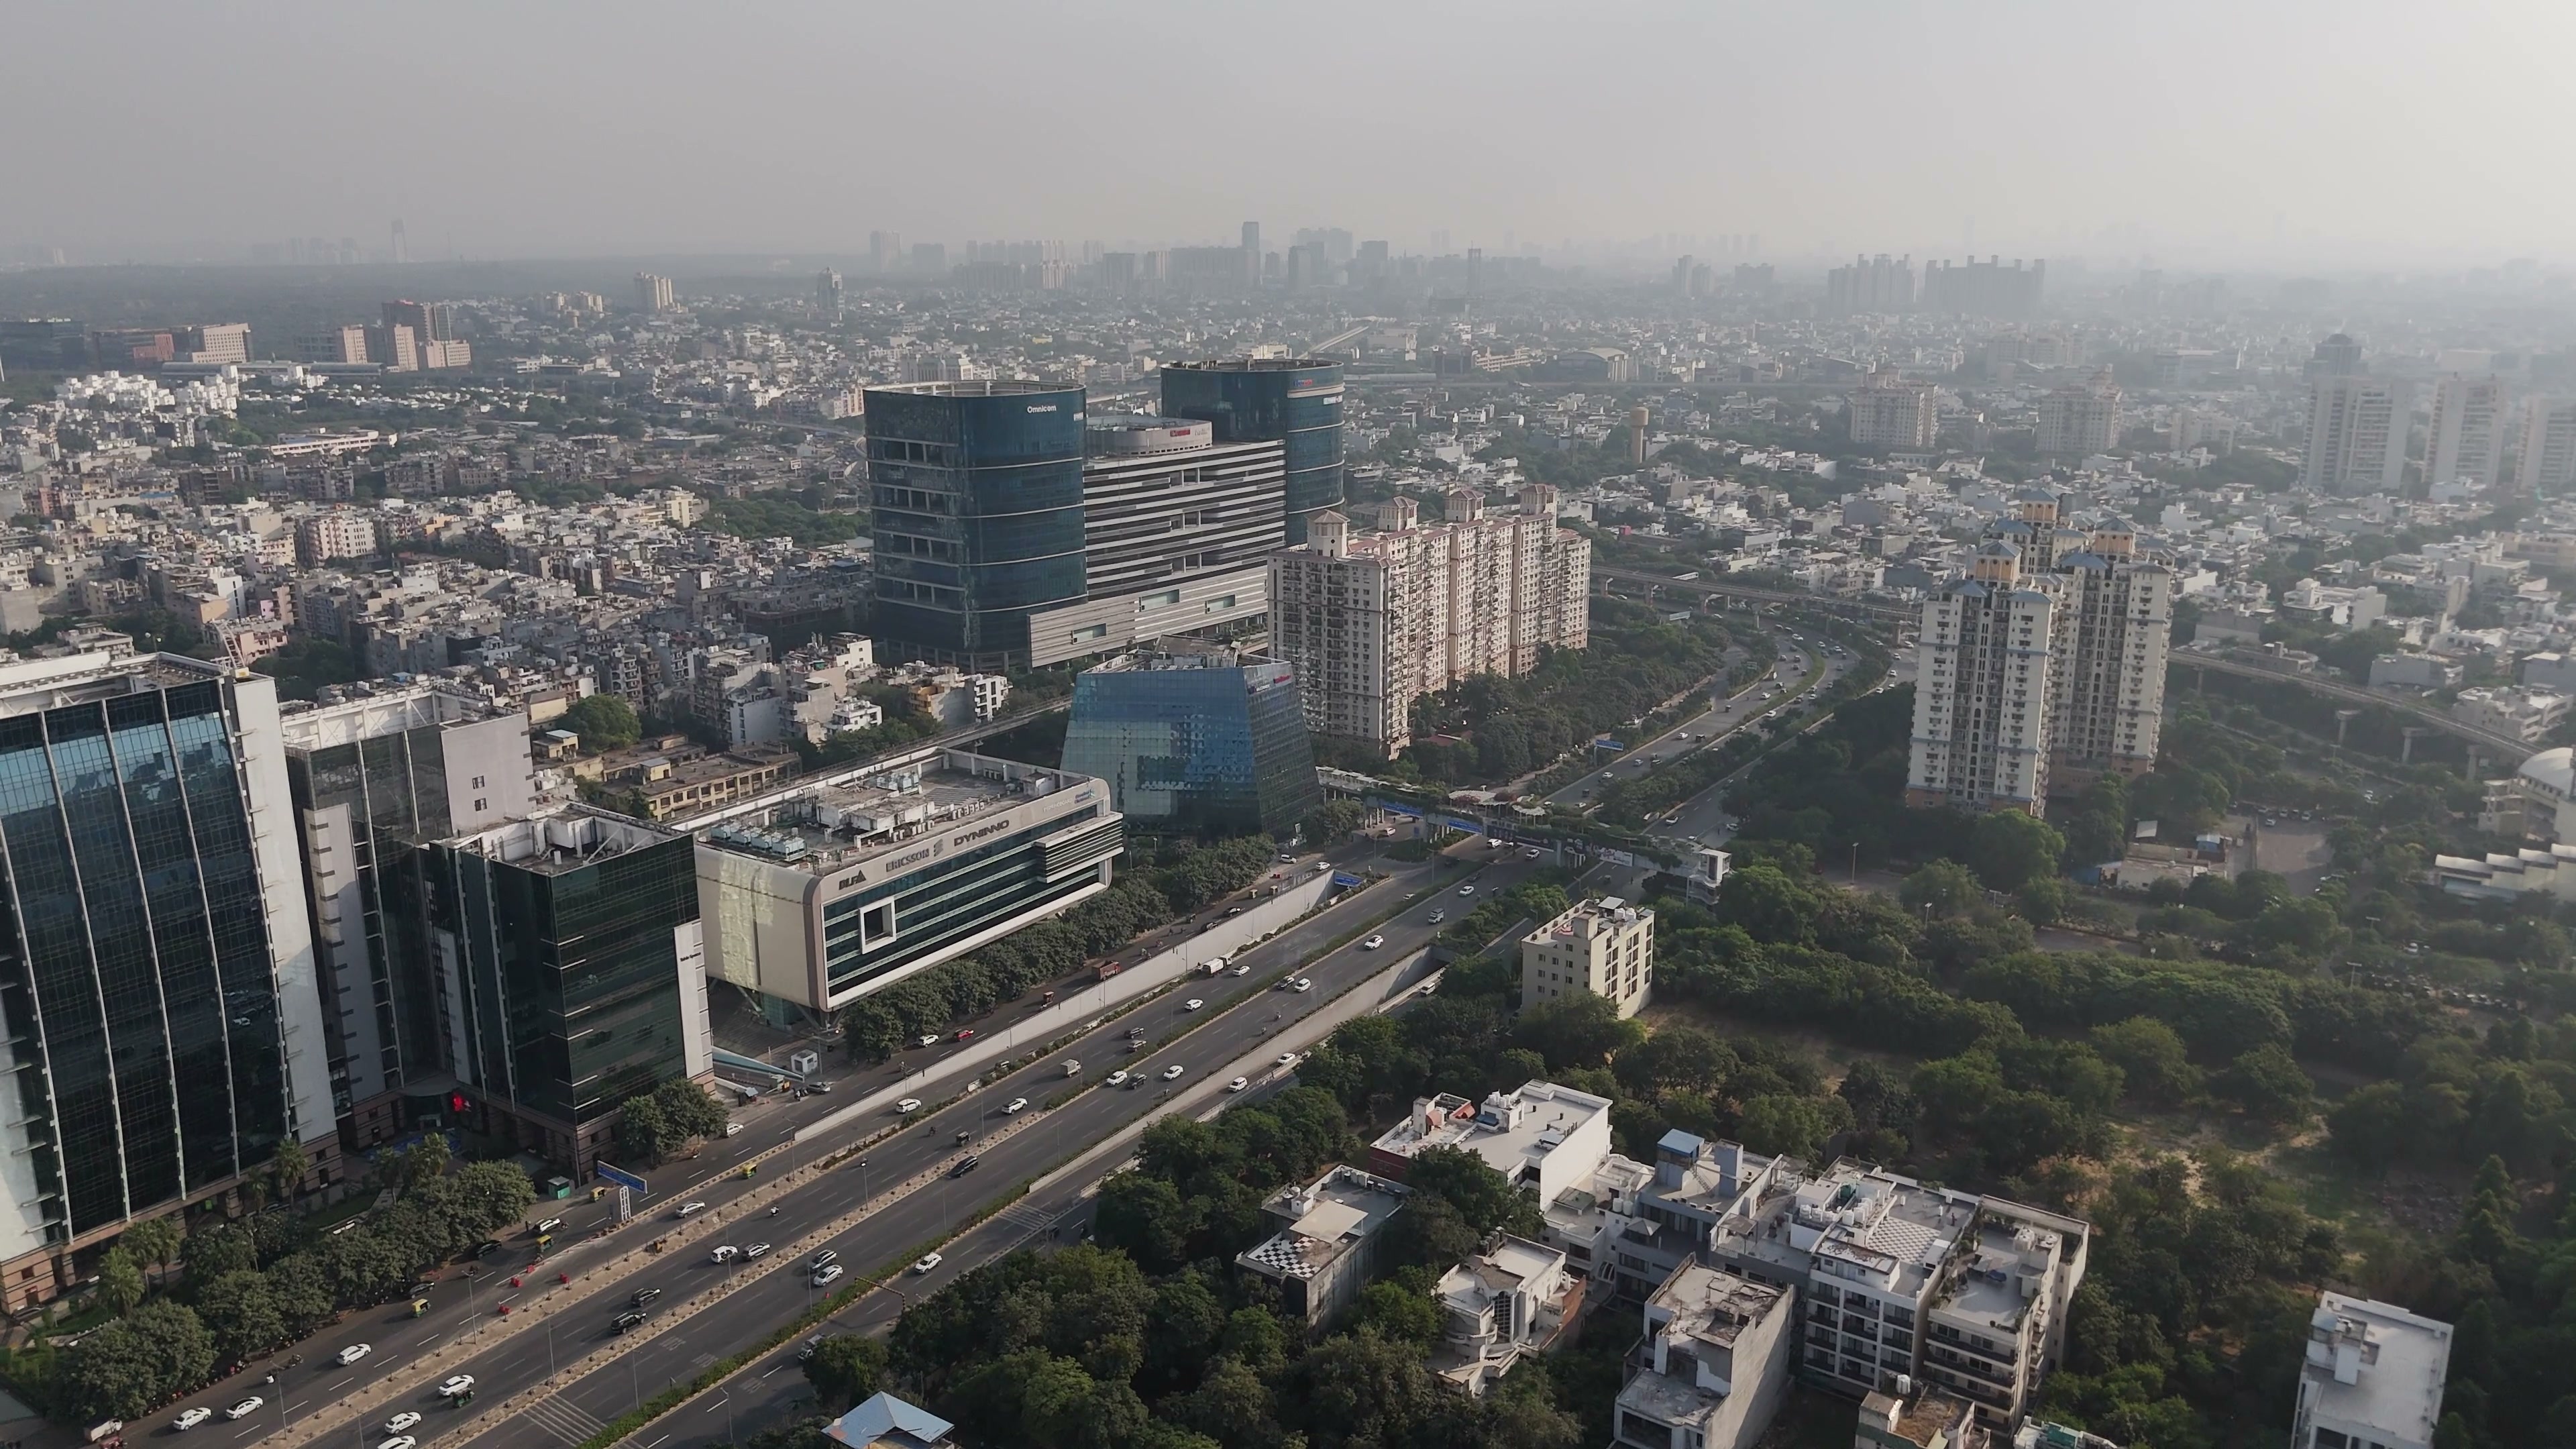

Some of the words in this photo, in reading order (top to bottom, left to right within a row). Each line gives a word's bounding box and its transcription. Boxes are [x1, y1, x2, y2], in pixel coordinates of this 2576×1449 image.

[1026, 405, 1057, 413] Omnicom
[954, 819, 1010, 847] DYNINNO
[885, 848, 930, 873] ERICSSON
